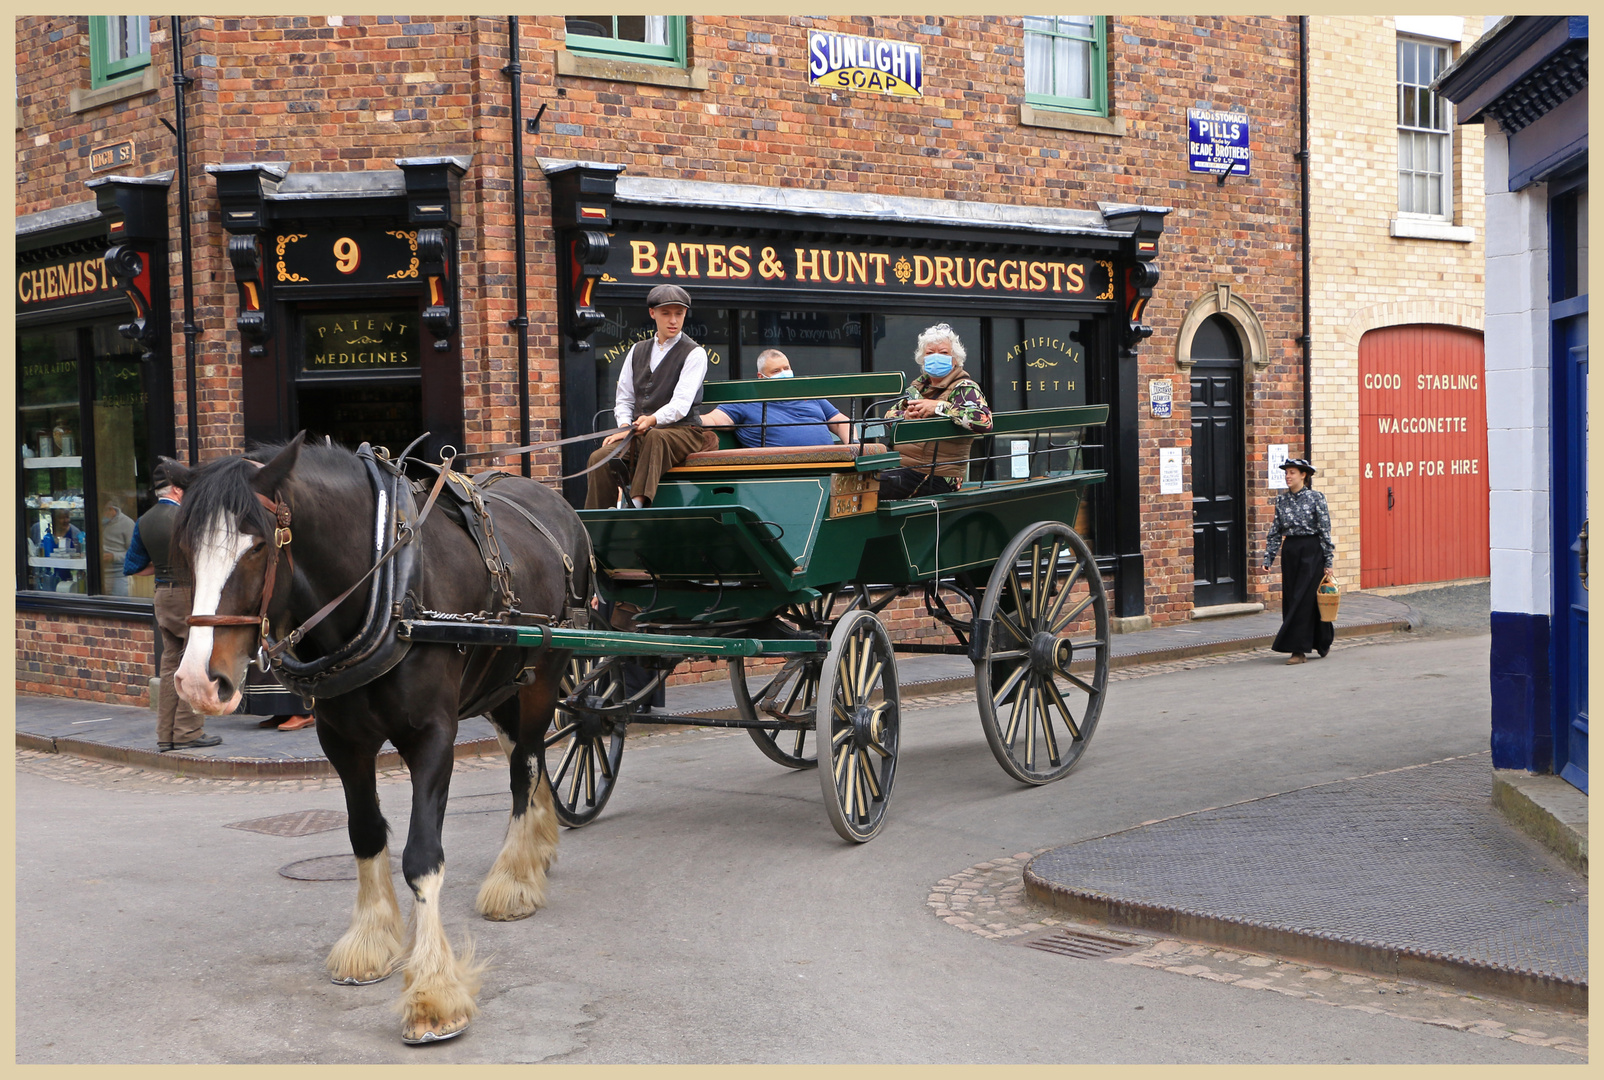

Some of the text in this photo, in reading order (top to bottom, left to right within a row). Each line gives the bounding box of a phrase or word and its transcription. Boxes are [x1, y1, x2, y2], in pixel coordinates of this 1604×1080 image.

[810, 33, 920, 89] SUNLIGHT
[838, 70, 897, 90] SOAP
[1191, 110, 1211, 120] HEAD
[1215, 112, 1247, 124] STOMACH
[1199, 120, 1240, 140] PILLS
[1190, 141, 1249, 160] READE BROTHERS
[333, 237, 361, 274] 9
[630, 240, 1086, 294] BATES & HUNT DRUGGISTS
[318, 319, 407, 338] PATENT
[315, 351, 408, 365] MEDICINES
[1006, 336, 1079, 363] ARTIFICIAL
[1011, 380, 1075, 391] TEETH
[1364, 373, 1478, 390] GOOD STABLING
[1378, 417, 1467, 433] WAGGONETTE
[1364, 459, 1479, 478] & TRAP FOR HIRE
